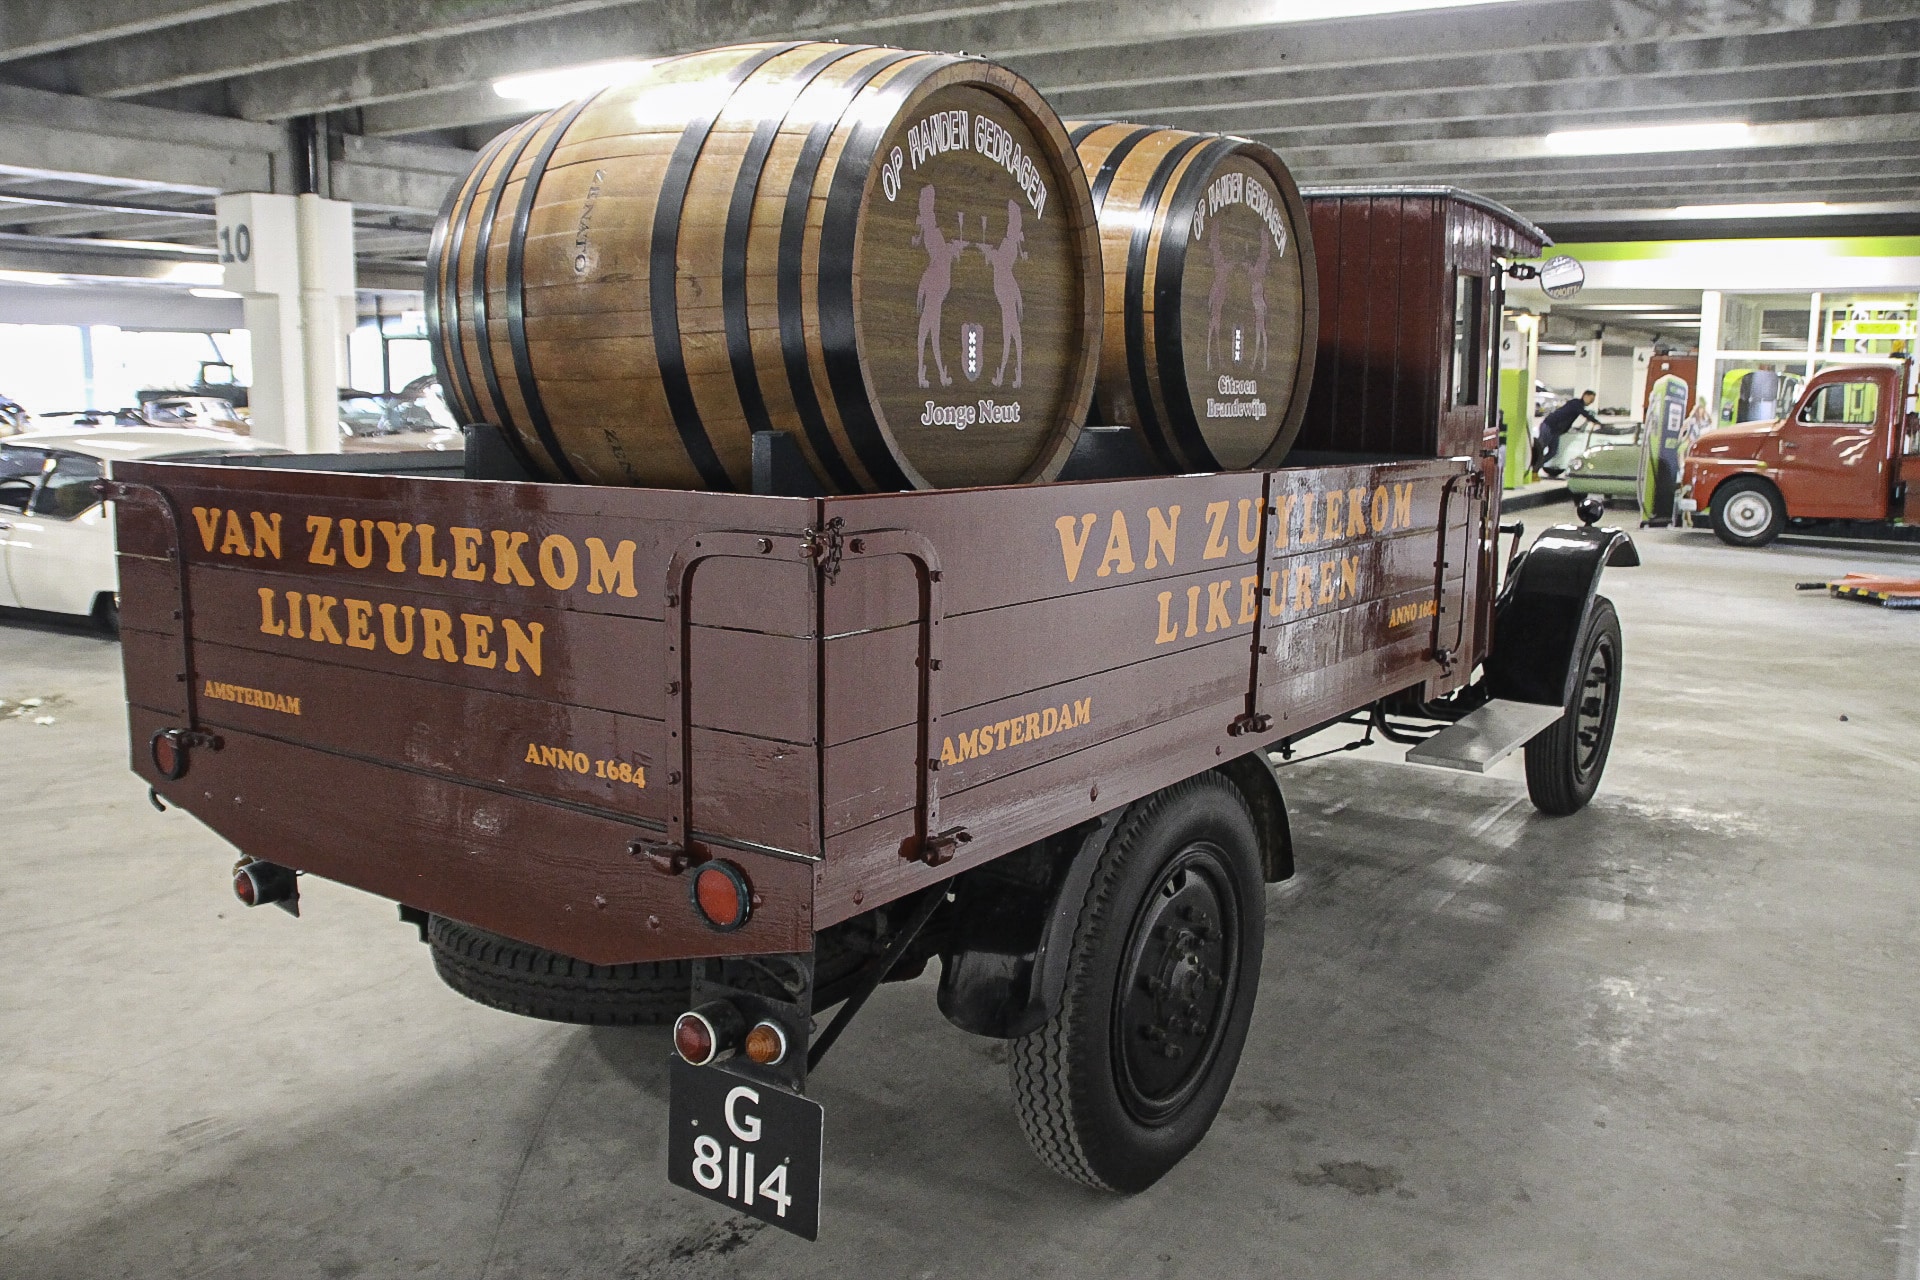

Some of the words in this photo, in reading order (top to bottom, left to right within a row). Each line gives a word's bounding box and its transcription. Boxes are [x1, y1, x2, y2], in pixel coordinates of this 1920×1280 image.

[882, 146, 903, 202] OP
[908, 110, 969, 170] HANDEN
[975, 114, 1047, 219] GEDRAGEN
[1194, 198, 1206, 241] OP
[1208, 173, 1243, 218] HANDEN
[1246, 176, 1287, 258] GEDRAGEN
[220, 223, 250, 263] 10
[1502, 337, 1510, 350] 6
[1580, 346, 1587, 358] 5
[1638, 352, 1644, 362] 4
[1218, 375, 1257, 394] Citroen
[921, 401, 975, 430] Jonge
[978, 400, 1020, 423] Neut
[192, 506, 282, 560] VAN
[305, 514, 638, 598] ZUYLEKOM
[1054, 506, 1181, 582] VAN
[1203, 482, 1413, 561] ZUYLEKOM
[1155, 556, 1359, 645] LIKEUREN
[1388, 602, 1417, 629] ANNO
[257, 587, 544, 676] LIKEUREN
[203, 680, 300, 715] AMSTERDAM
[940, 697, 1092, 767] AMSTERDAM
[525, 743, 590, 774] ANNO
[595, 759, 646, 788] 1684
[724, 1085, 762, 1142] G
[692, 1134, 792, 1218] 8114
